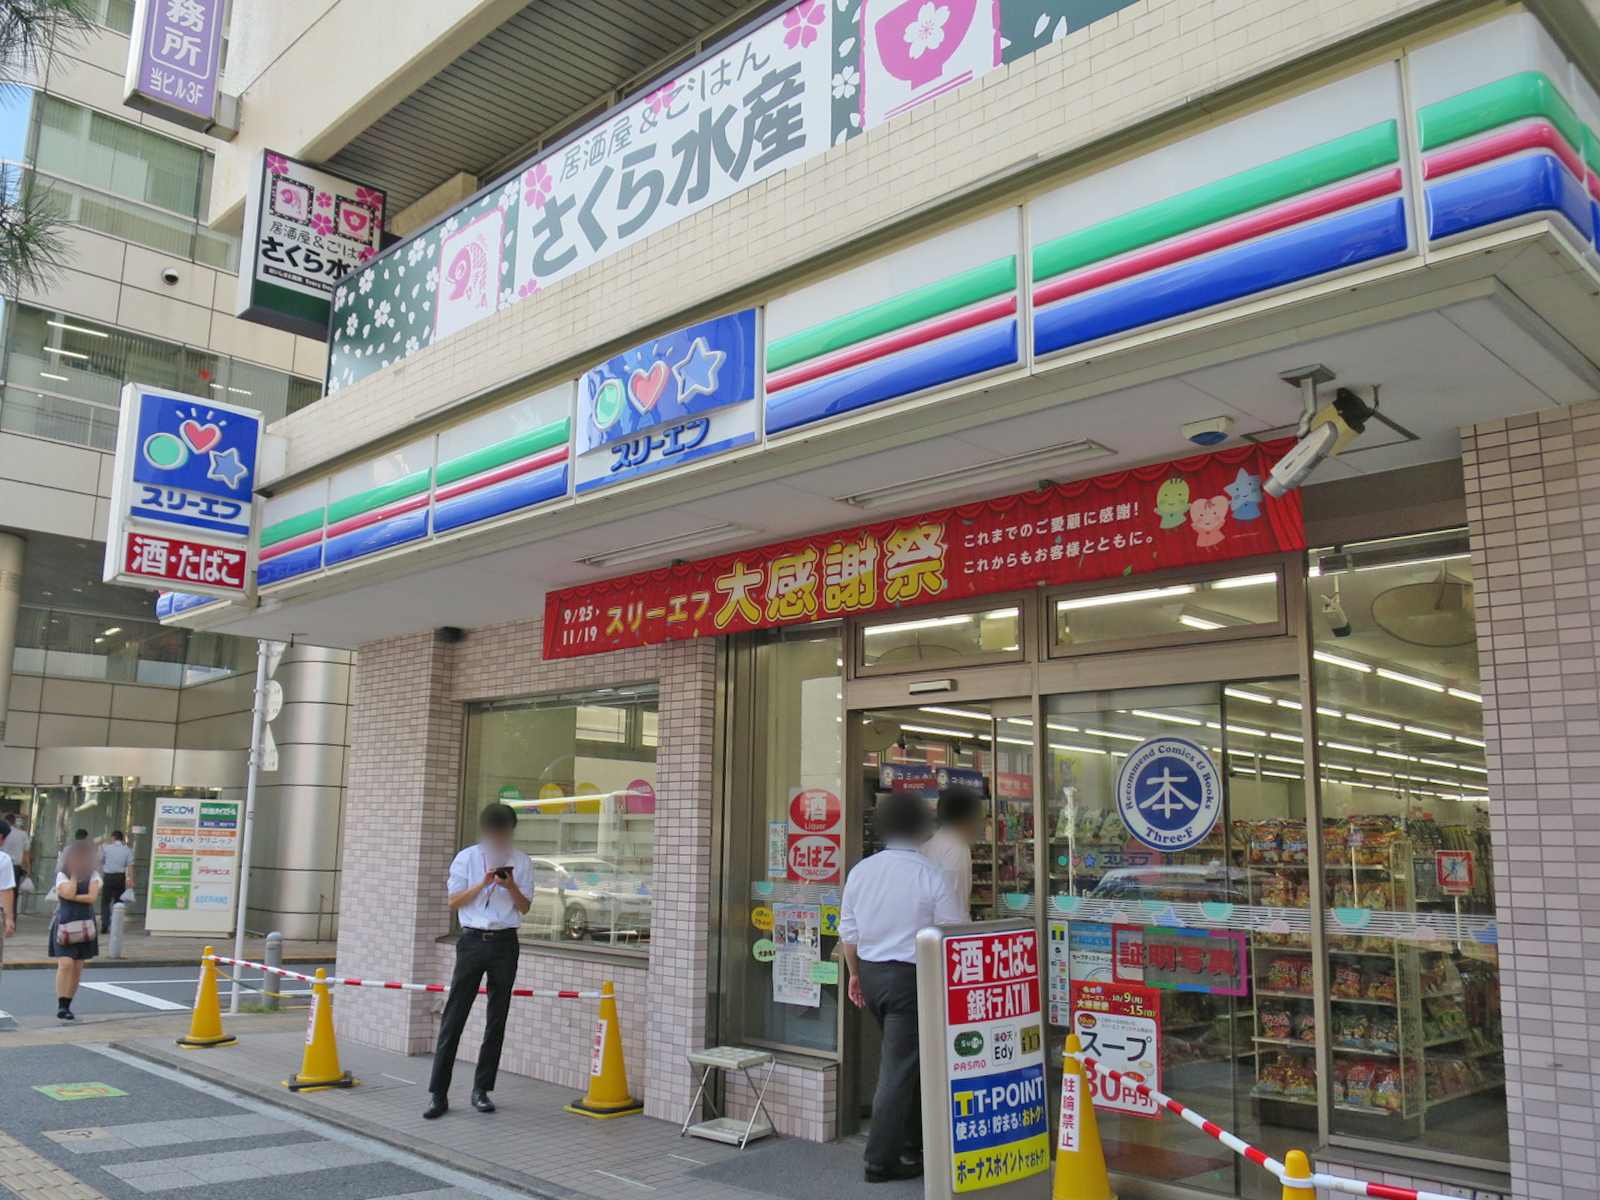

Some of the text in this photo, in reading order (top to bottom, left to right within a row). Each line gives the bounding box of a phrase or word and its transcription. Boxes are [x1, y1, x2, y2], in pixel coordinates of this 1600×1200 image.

[161, 0, 206, 67] 務所
[150, 67, 205, 104] 当ビル3F
[532, 61, 806, 277] さくら水産
[611, 418, 709, 472] スリーエフ
[141, 486, 242, 519] スリーエフ
[963, 502, 1140, 548] これまでのご愛顧に感謝!
[131, 536, 240, 585] 酒・たばこ
[963, 533, 1154, 574] これからもお客様とともに。
[606, 521, 945, 636] スリーエフ 大感謝祭
[562, 625, 598, 645] 11/19
[1125, 748, 1156, 811] Recommend
[1158, 745, 1196, 763] Comics
[1202, 772, 1215, 810] Books
[1138, 766, 1200, 819] 本
[161, 805, 194, 815] SECOM
[803, 791, 828, 821] 酒
[804, 822, 826, 831] Liquor
[1145, 826, 1194, 844] Three-F
[793, 845, 837, 868] たばこ
[801, 868, 829, 877] TOBACCO
[951, 934, 1037, 984] 酒・たばこ
[1121, 941, 1236, 977] 証明写真
[966, 982, 1031, 1021] 銀行ATM
[994, 1044, 1014, 1060] Edy
[1081, 1031, 1152, 1061] スープ
[953, 1059, 987, 1072] PASMO
[974, 1076, 1044, 1114] T-POINT
[1061, 1077, 1076, 1148] 駐輪禁止
